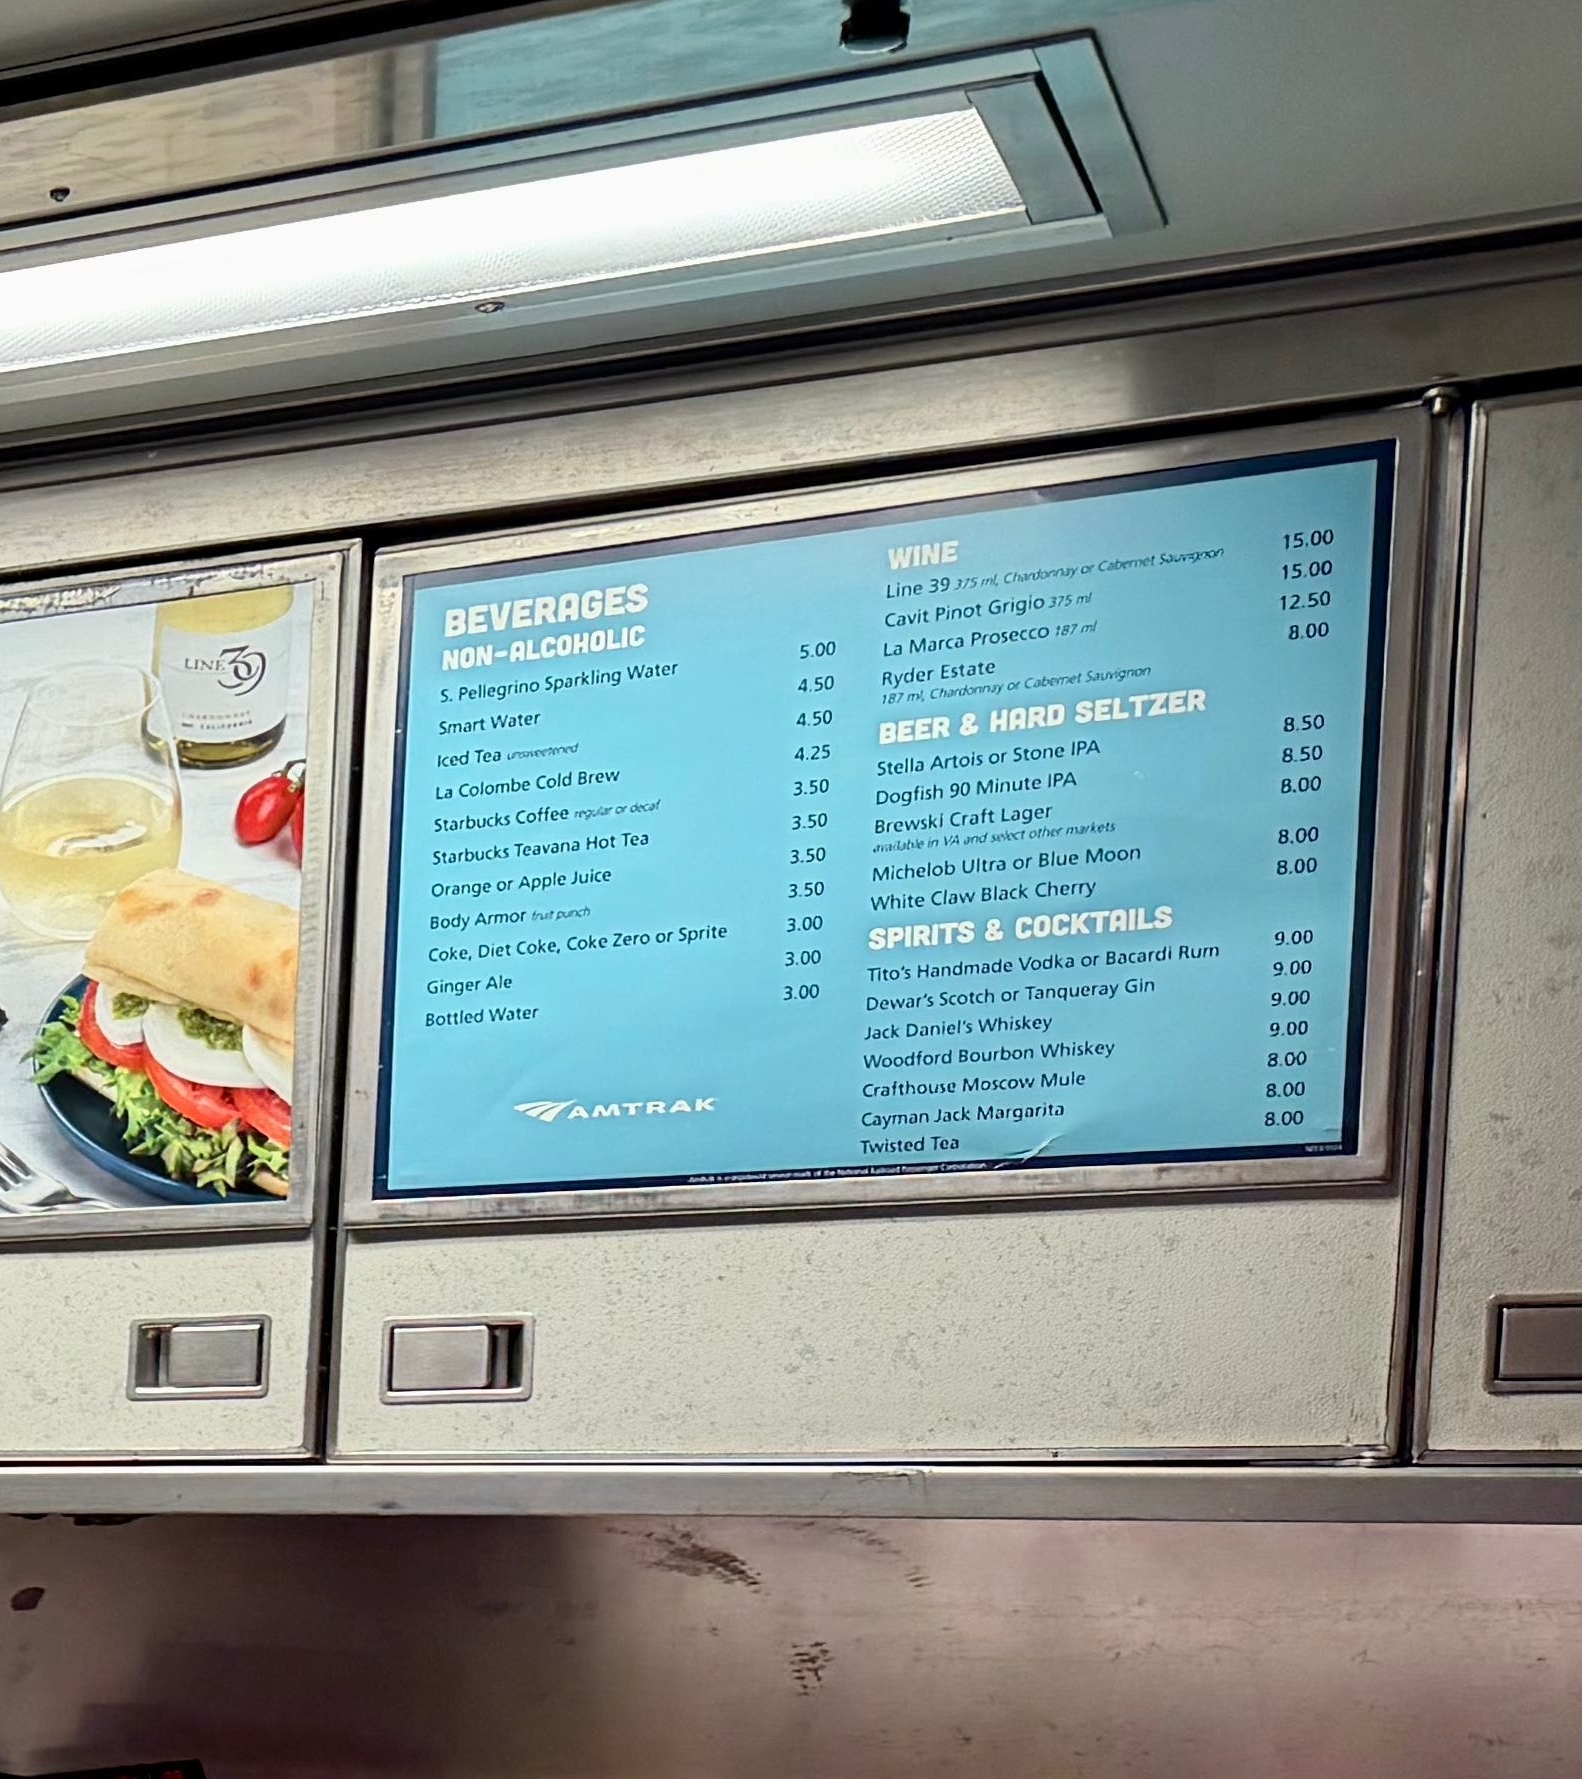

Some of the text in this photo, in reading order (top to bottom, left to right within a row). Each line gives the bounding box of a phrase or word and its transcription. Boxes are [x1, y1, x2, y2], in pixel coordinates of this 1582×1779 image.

[1283, 529, 1334, 550] 15.00
[888, 540, 958, 569] WINE
[1282, 560, 1332, 580] 15.00
[445, 583, 648, 637] BEVERAGES
[885, 609, 928, 627] Cavit
[935, 604, 981, 621] Pinot
[988, 594, 1044, 615] Grigio
[1048, 594, 1071, 608] 375
[442, 625, 645, 670] NON-ALCOHOLIC
[800, 641, 836, 659] 5.00
[184, 657, 225, 672] LINE
[441, 663, 677, 702] S. Pellegrino Sparkling Water
[439, 713, 540, 735] Smart Water
[879, 689, 1205, 744] BEER & HARD SELTZER
[1283, 714, 1324, 732] 8.50
[437, 750, 469, 767] Iced
[474, 749, 501, 763] Tea
[794, 744, 830, 761] 4.25
[877, 740, 1100, 776] Stella Artois or Stone IPA
[436, 771, 619, 799] La Colombe Cold Brew
[434, 812, 510, 832] Starbucks
[515, 806, 568, 824] Coffee
[431, 869, 611, 897] Orange or Apple Juice
[868, 906, 1172, 949] SPIRITS & COCKTAILS
[1275, 930, 1313, 946] 9.00
[427, 975, 512, 996] Ginger Ale
[783, 984, 819, 1000] 3.00
[864, 1015, 1052, 1040] Jack Daniel's Whiskey
[567, 1098, 714, 1119] AMTRAK
[1265, 1111, 1304, 1126] 8.00
[860, 1136, 958, 1154] Twisted Tea
